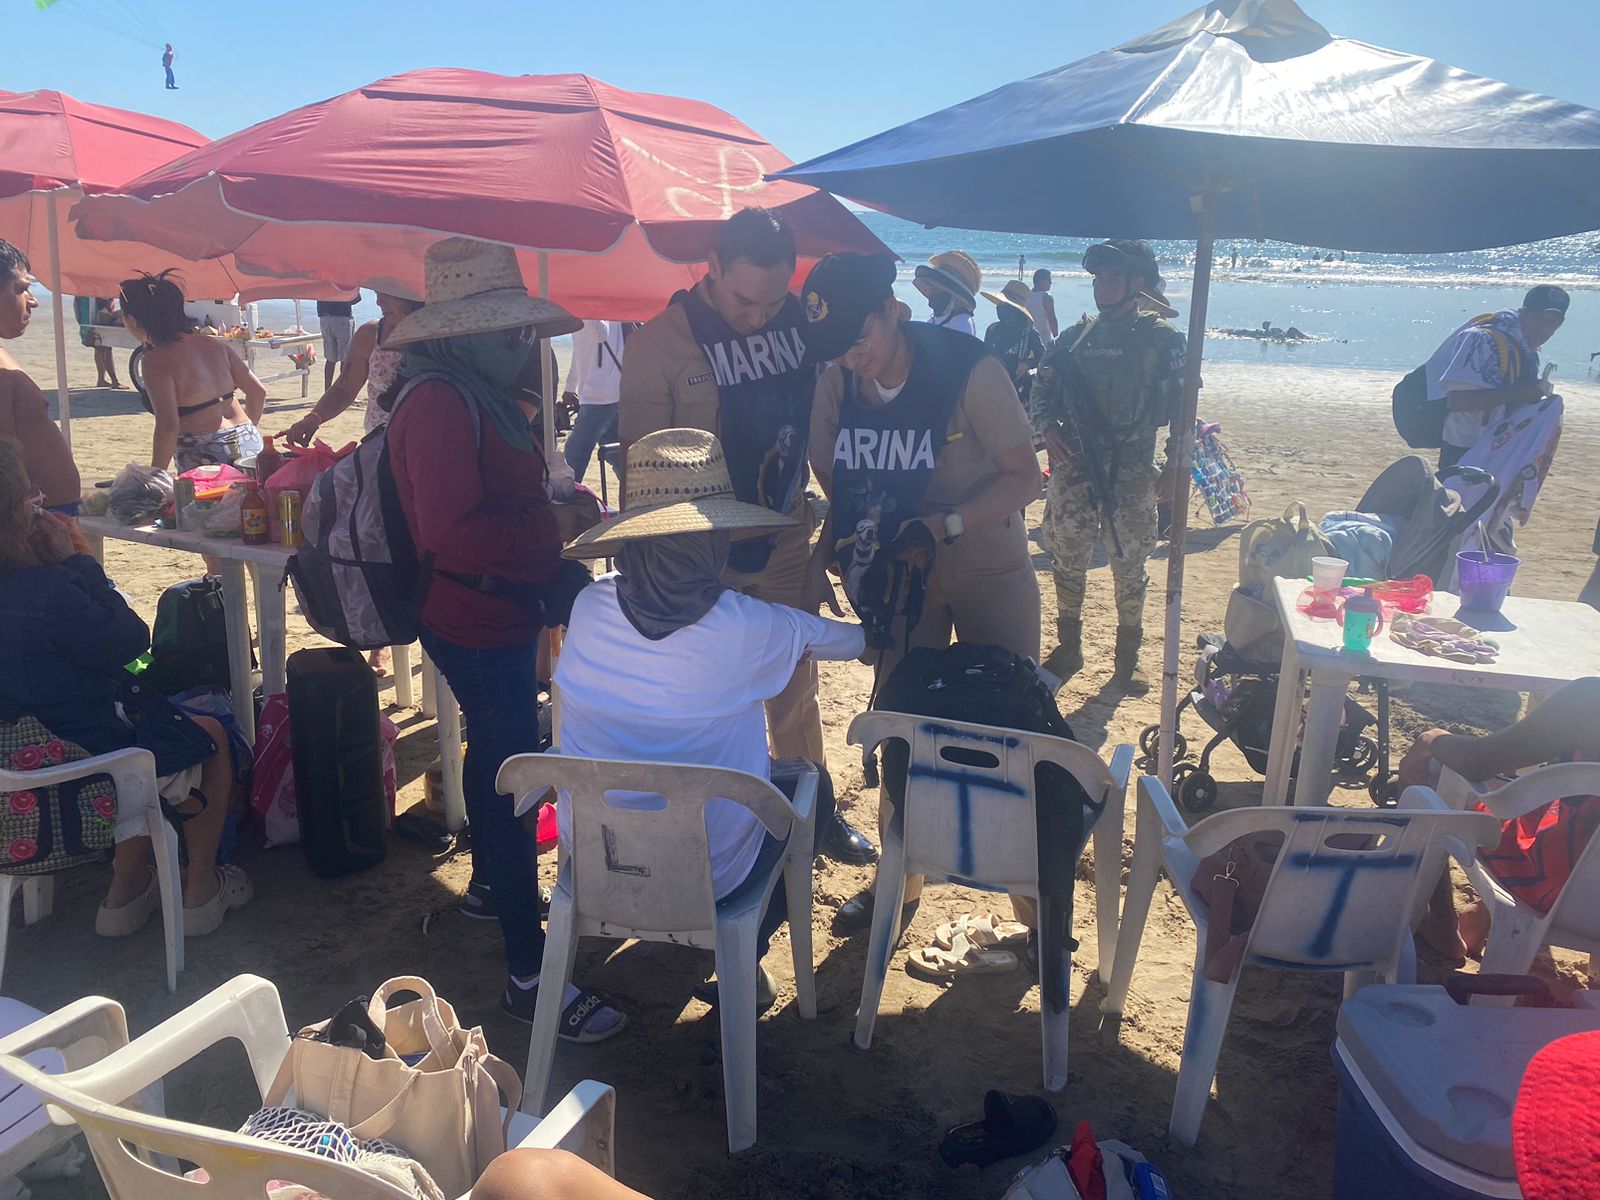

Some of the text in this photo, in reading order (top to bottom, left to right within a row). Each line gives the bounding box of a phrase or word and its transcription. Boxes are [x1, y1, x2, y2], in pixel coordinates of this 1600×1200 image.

[833, 427, 935, 471] ARINA
[601, 824, 651, 878] L
[568, 995, 602, 1027] adida
